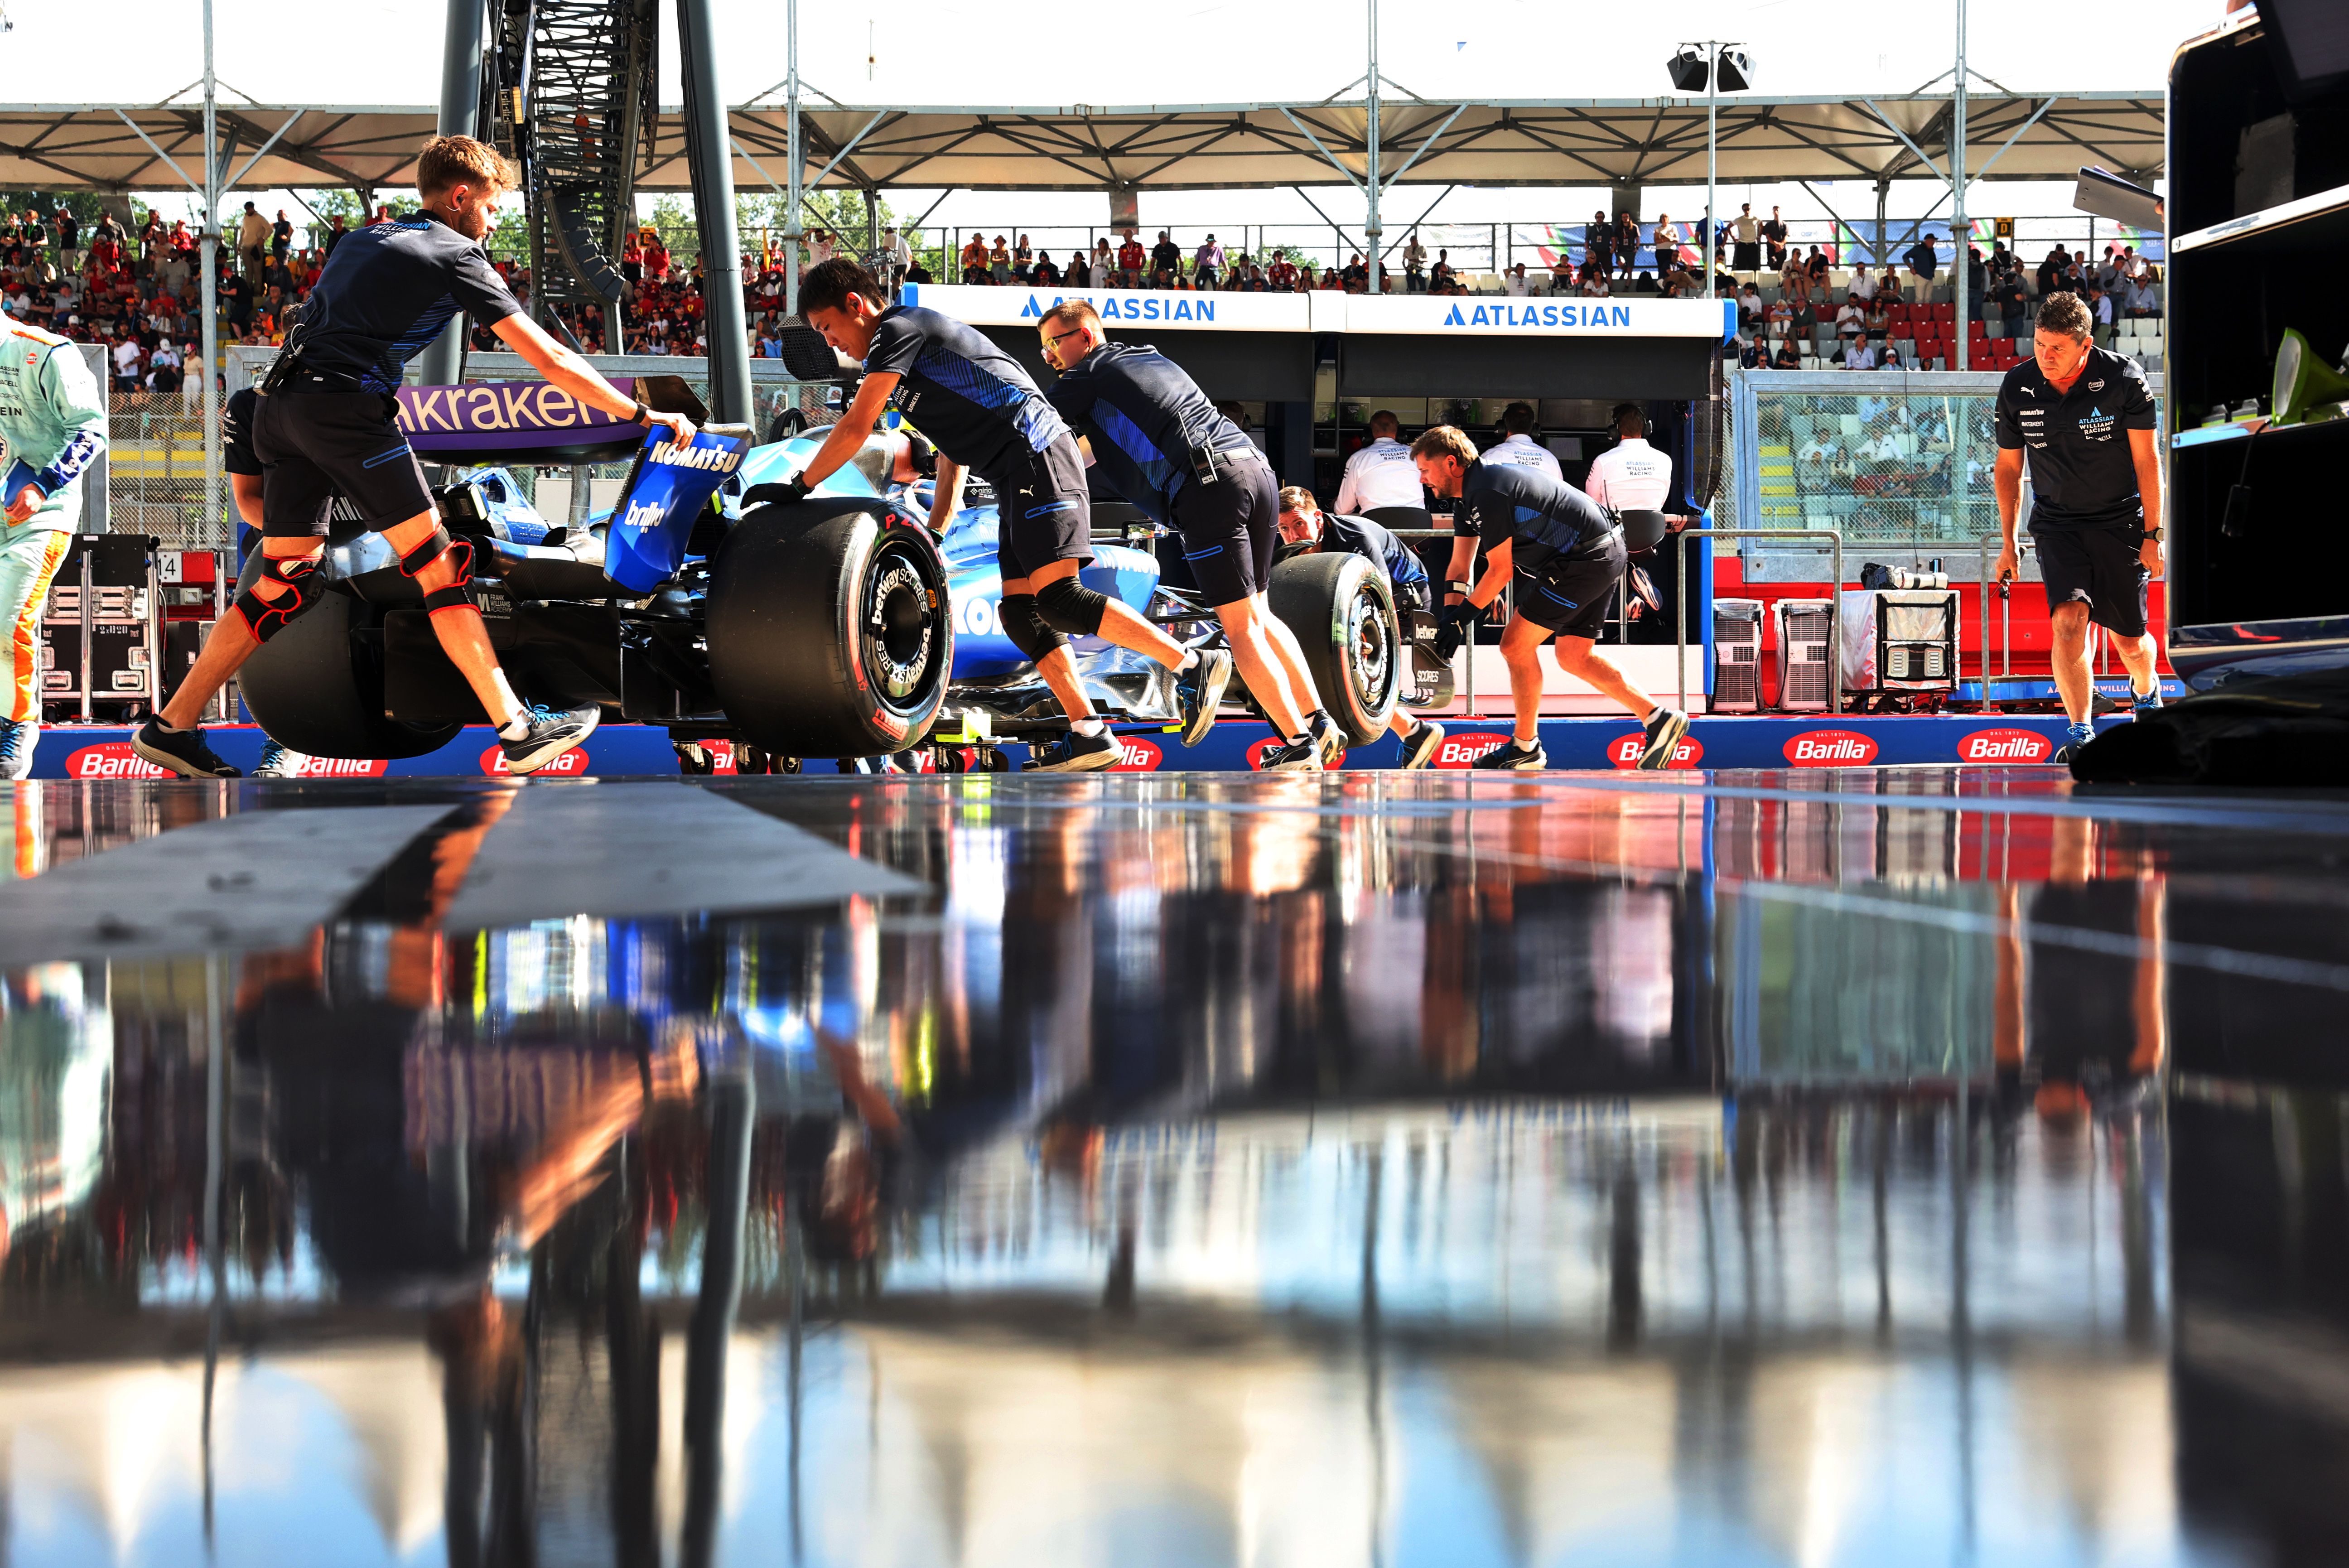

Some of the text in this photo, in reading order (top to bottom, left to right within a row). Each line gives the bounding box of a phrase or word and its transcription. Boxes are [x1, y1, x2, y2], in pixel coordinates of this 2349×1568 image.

[369, 229, 410, 237] RACING
[375, 225, 424, 235] WILLIAMS
[2001, 223, 2007, 233] D
[1052, 297, 1214, 321] ASSIAN
[1471, 305, 1630, 327] ATLASSIAN
[0, 407, 22, 416] EIN
[907, 392, 921, 413] DURACELL
[2079, 415, 2114, 424] ATLASSIAN
[2079, 420, 2113, 429] WILLIAMS
[2084, 426, 2111, 435] RACING
[649, 440, 741, 473] KOMATSU
[885, 513, 896, 529] P
[872, 568, 928, 624] betway SCORES
[876, 628, 931, 684] betway SCORES
[1417, 670, 1439, 683] SCORES
[872, 707, 909, 741] PIRELLI
[1441, 742, 1502, 762] Bari
[1795, 739, 1866, 759] Barilla
[1969, 738, 2040, 758] Barilla
